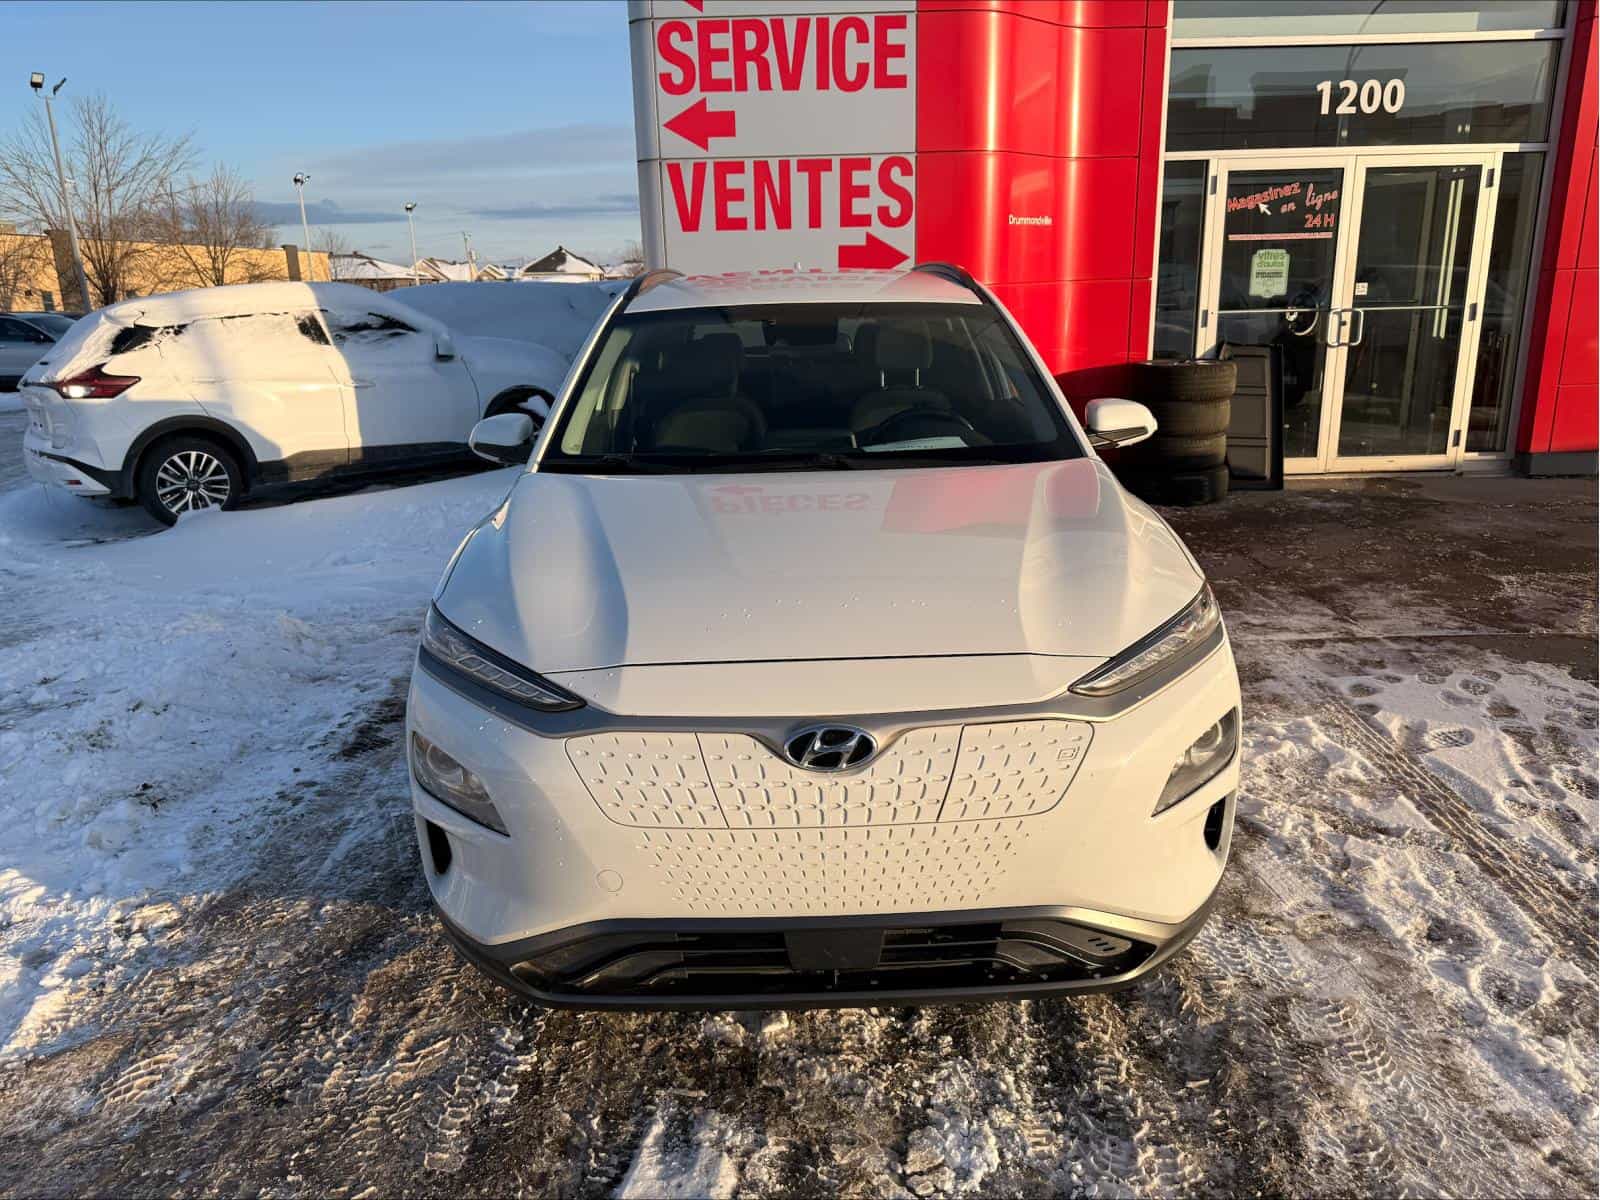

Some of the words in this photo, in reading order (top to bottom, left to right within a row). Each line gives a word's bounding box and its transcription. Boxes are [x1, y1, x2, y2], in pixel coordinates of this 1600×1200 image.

[657, 15, 908, 96] SERVICE
[1316, 78, 1406, 115] 1200
[667, 155, 914, 232] VENTES
[1227, 182, 1301, 212] Magasinez
[1280, 202, 1296, 214] en
[1305, 182, 1338, 211] ligne
[1008, 214, 1052, 225] Drummondville
